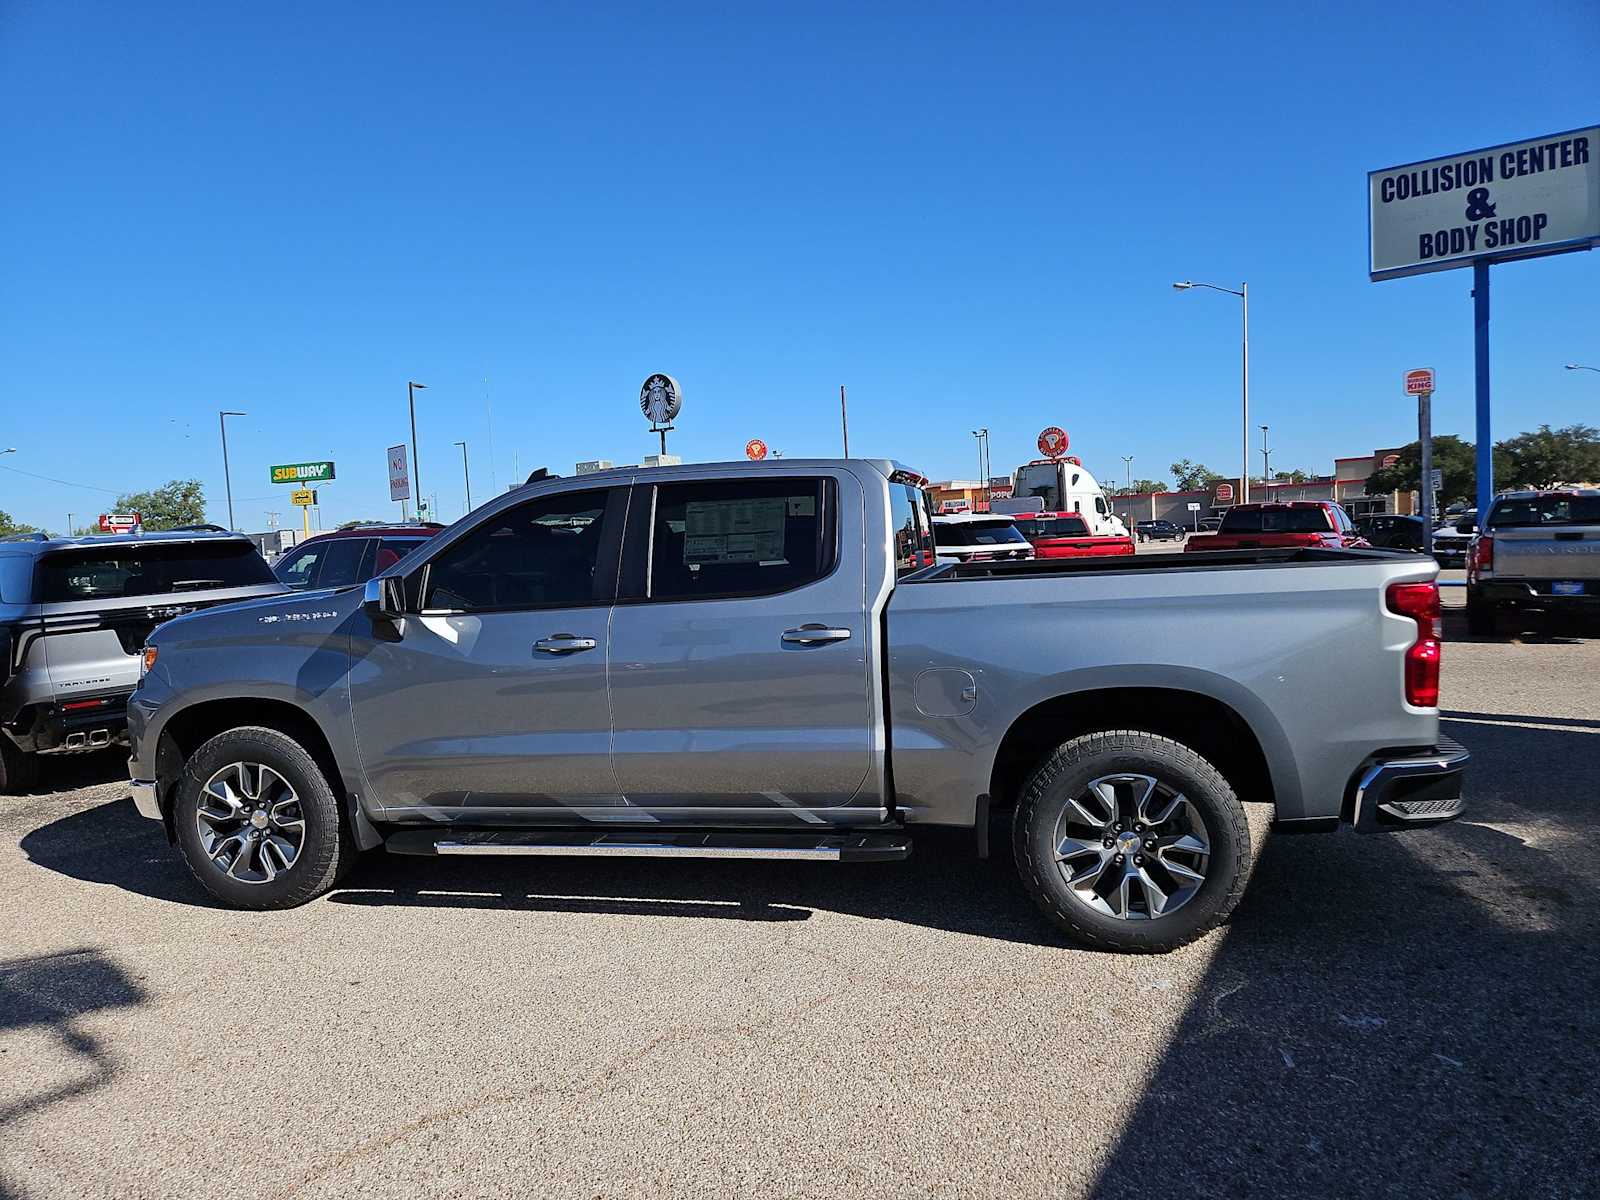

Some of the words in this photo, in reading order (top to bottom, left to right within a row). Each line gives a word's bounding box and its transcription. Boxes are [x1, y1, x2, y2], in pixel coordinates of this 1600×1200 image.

[1381, 156, 1493, 203] COLLISION
[1500, 137, 1589, 179] CENTER
[1465, 187, 1497, 222] &
[1419, 224, 1479, 259] BODY
[1484, 213, 1547, 248] SHOP
[1408, 381, 1432, 390] KING
[273, 464, 328, 480] SUBWAY
[393, 458, 402, 471] NO
